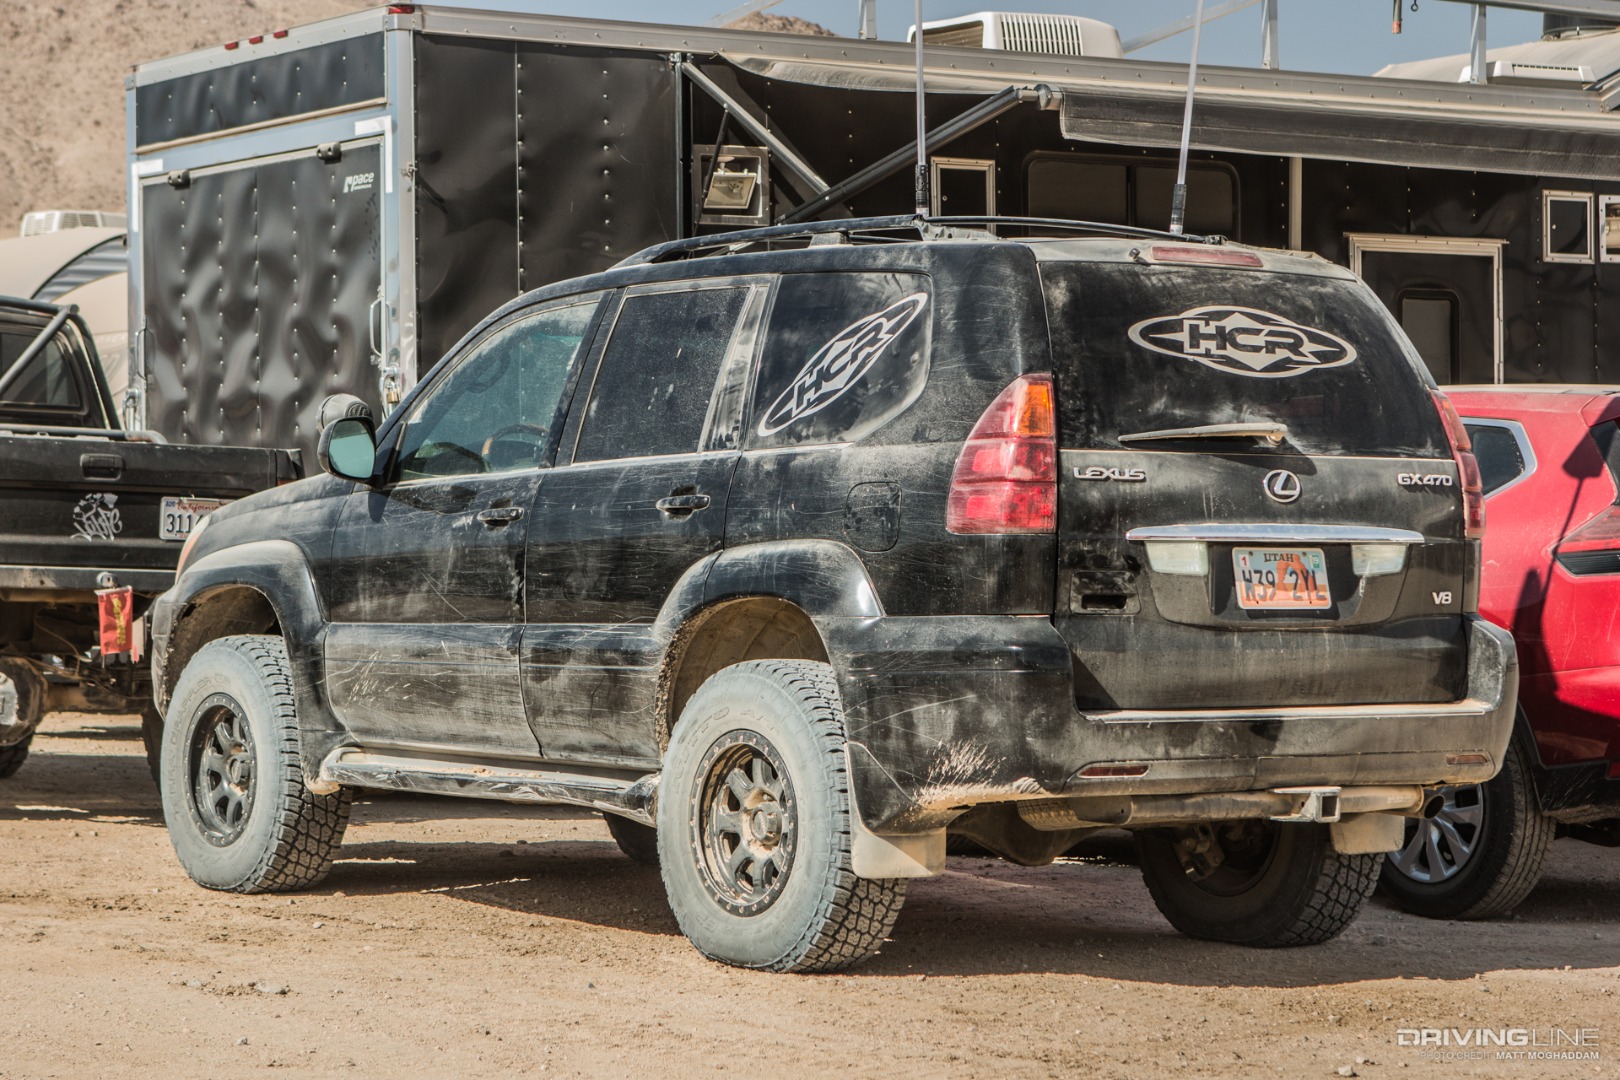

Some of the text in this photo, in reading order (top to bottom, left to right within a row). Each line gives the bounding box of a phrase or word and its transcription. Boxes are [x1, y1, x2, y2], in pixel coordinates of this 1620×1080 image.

[1073, 466, 1146, 480] LEXUS
[1263, 553, 1294, 562] UTAH
[1289, 570, 1327, 601] 2YL
[1431, 591, 1452, 605] V8
